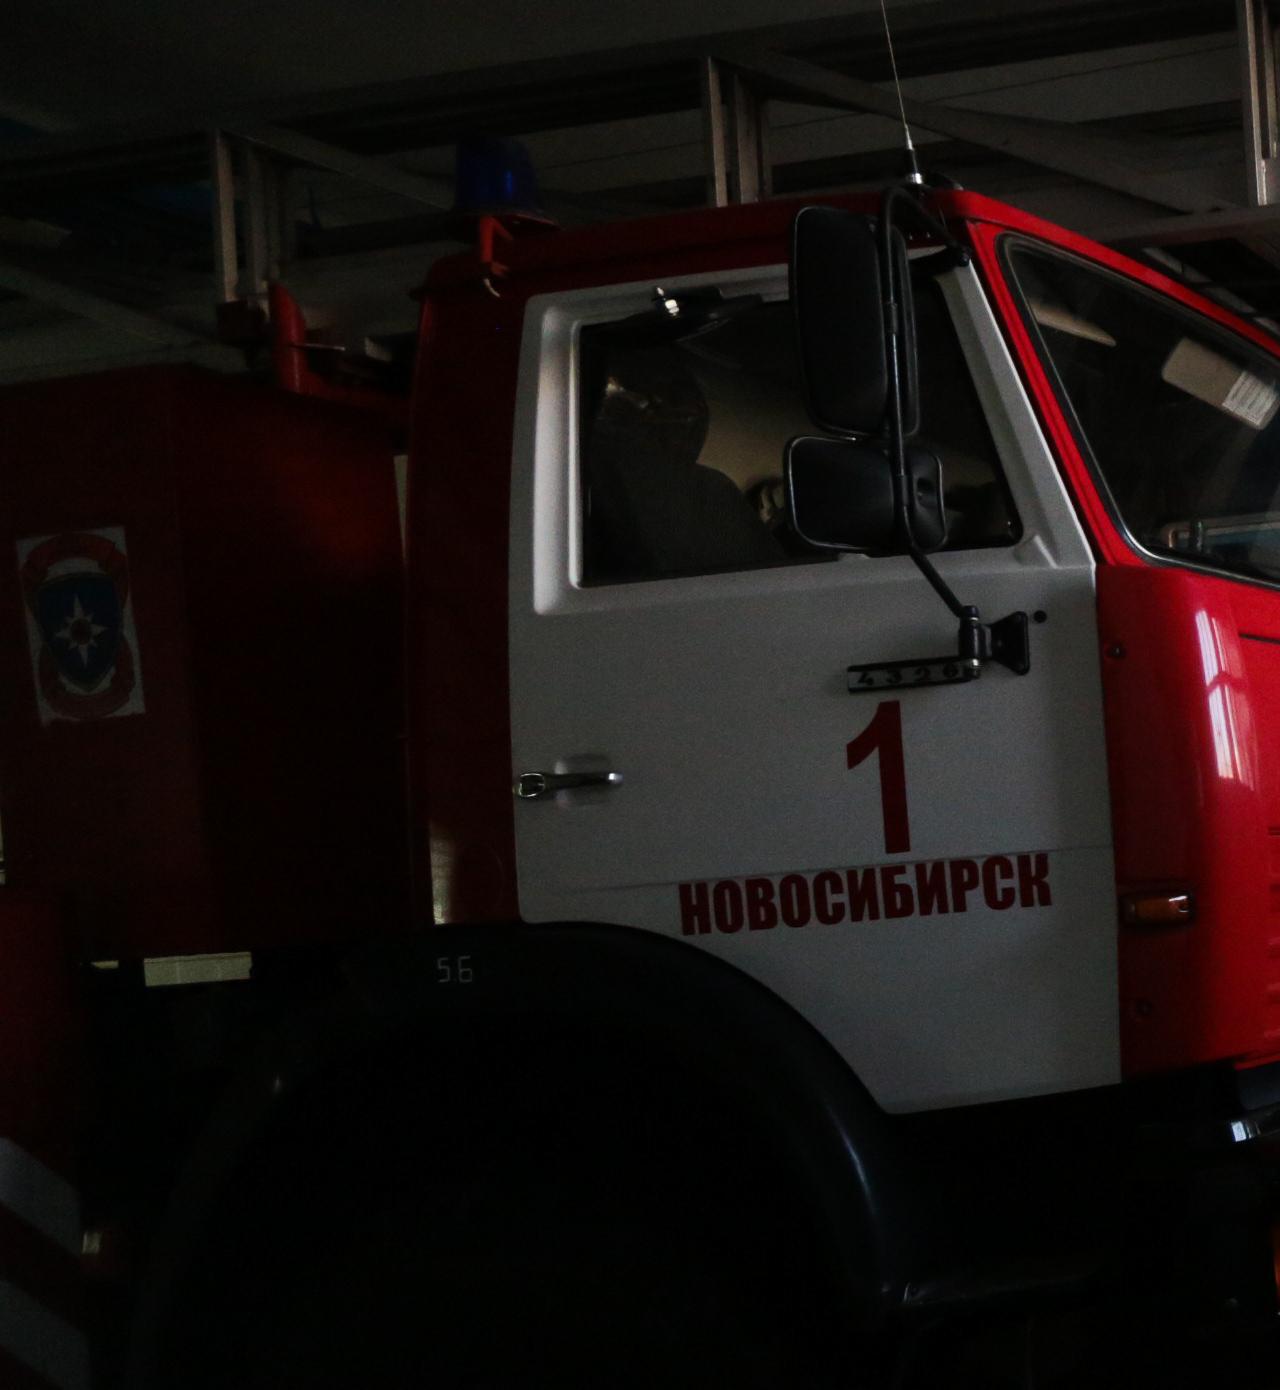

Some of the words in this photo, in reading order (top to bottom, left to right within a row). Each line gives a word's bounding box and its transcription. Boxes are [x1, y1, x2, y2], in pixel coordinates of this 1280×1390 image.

[858, 663, 959, 686] 4326
[846, 701, 911, 854] 1
[678, 853, 1053, 937] НОВОСИБИРСК
